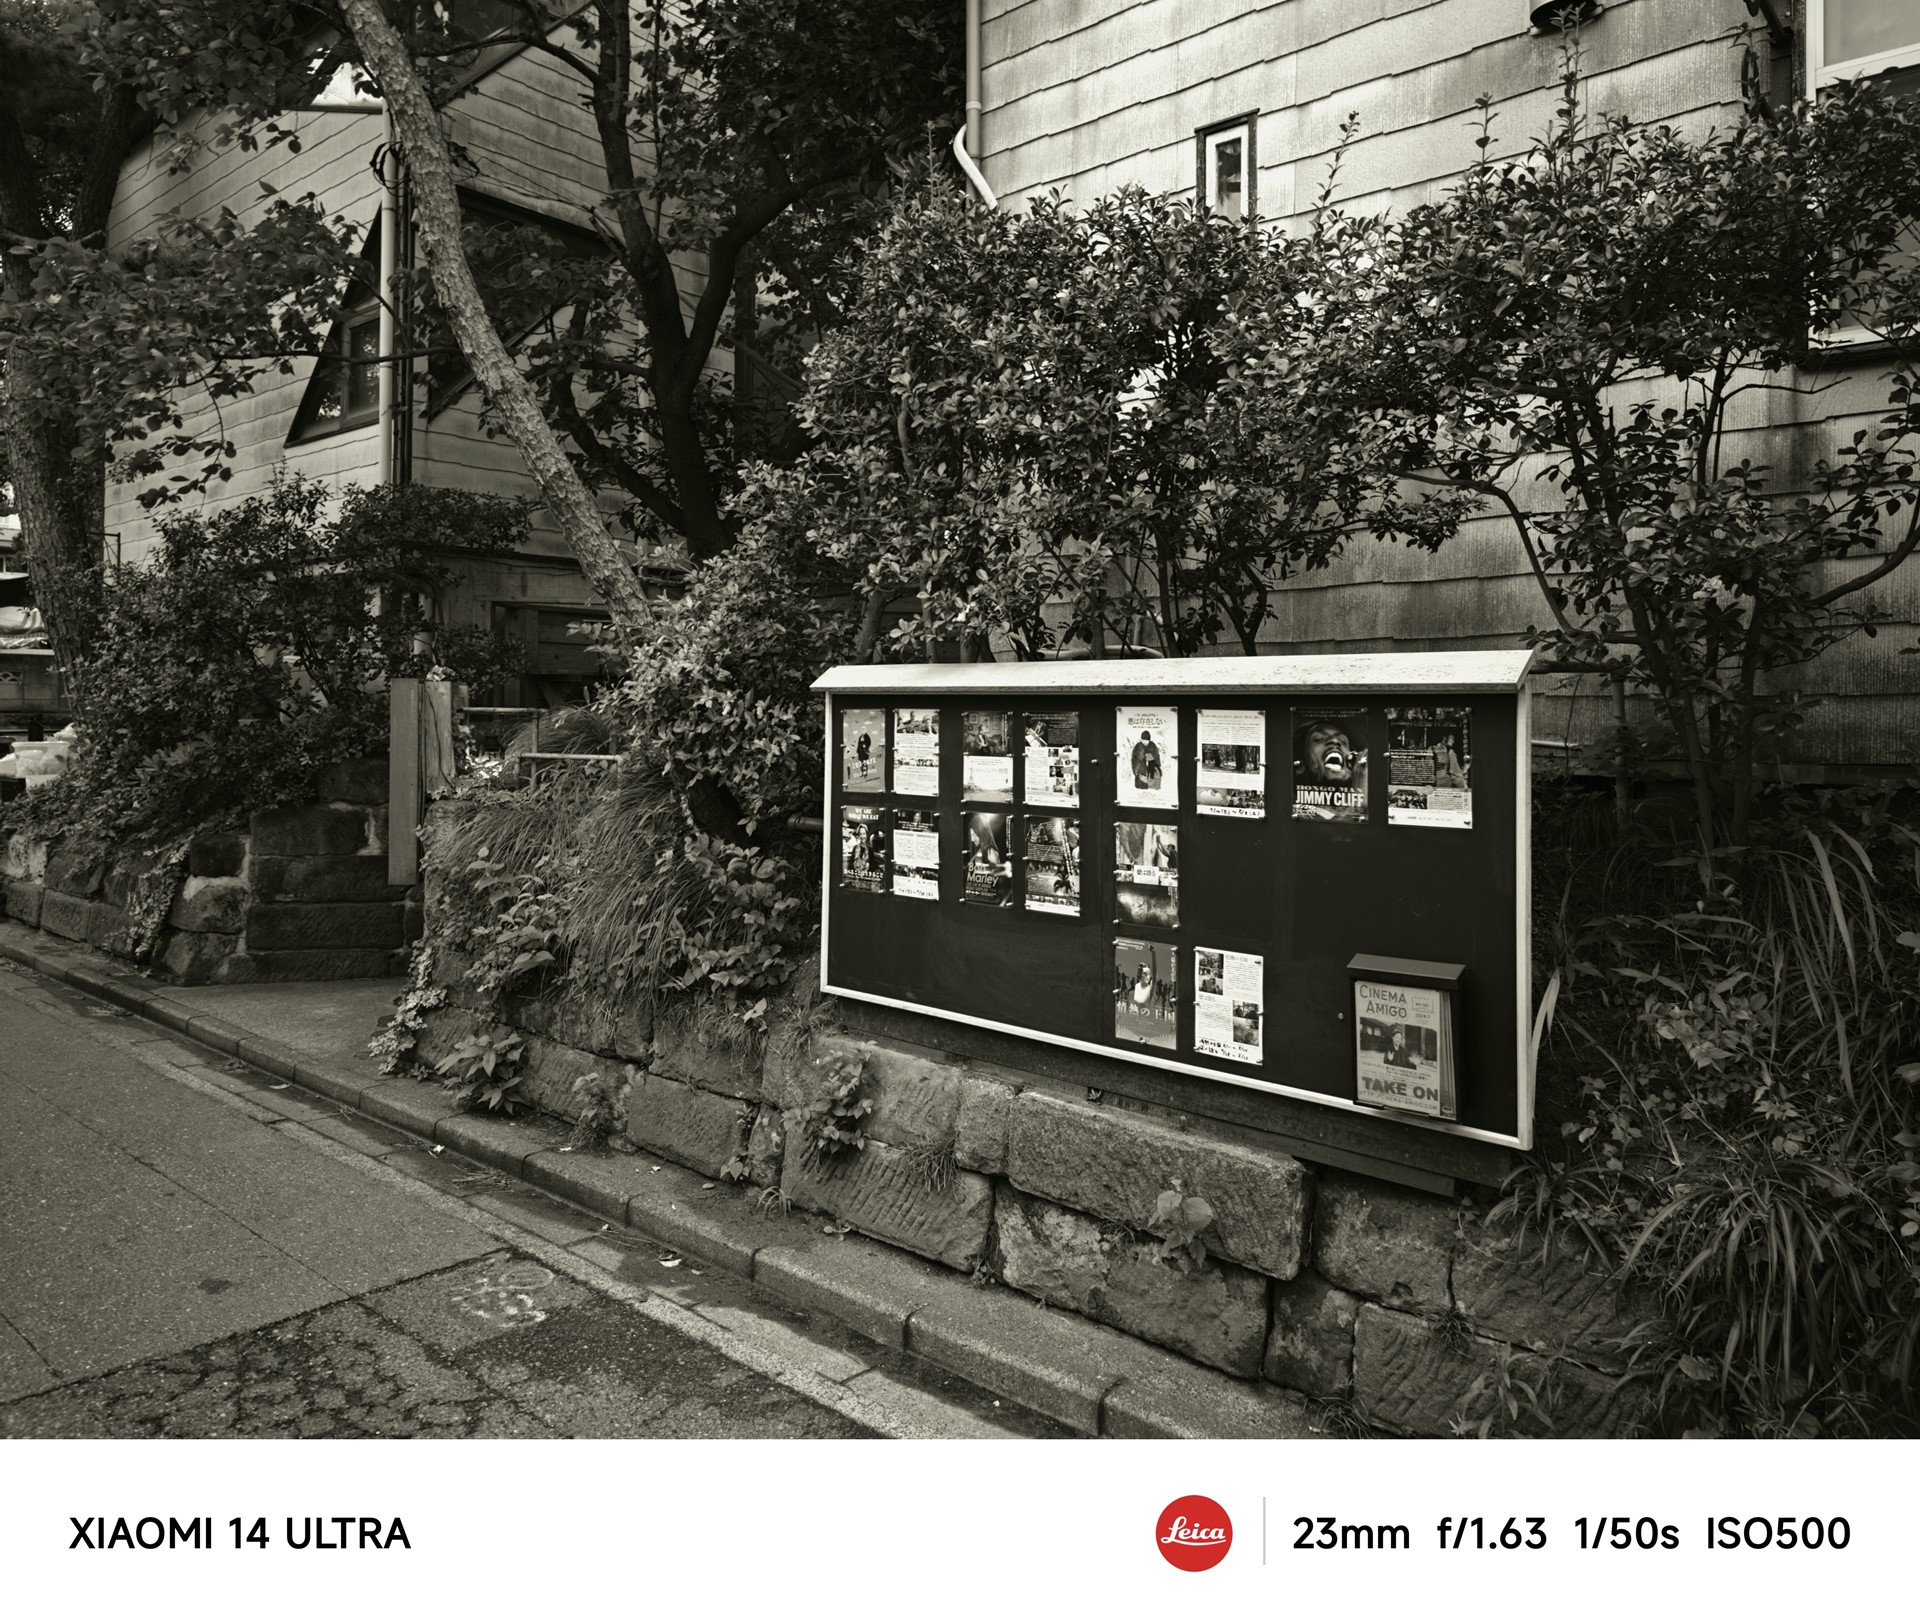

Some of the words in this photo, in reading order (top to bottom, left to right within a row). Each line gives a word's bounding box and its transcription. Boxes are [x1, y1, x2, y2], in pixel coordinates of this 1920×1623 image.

[1296, 784, 1336, 792] BONGO
[1295, 790, 1333, 806] JIMMY
[1333, 792, 1365, 807] CLIFF
[966, 871, 999, 887] Marley
[1359, 984, 1408, 1004] CINEMA
[1366, 1000, 1408, 1019] AMIGO
[1362, 1076, 1407, 1096] TAKE
[1412, 1086, 1439, 1102] ON
